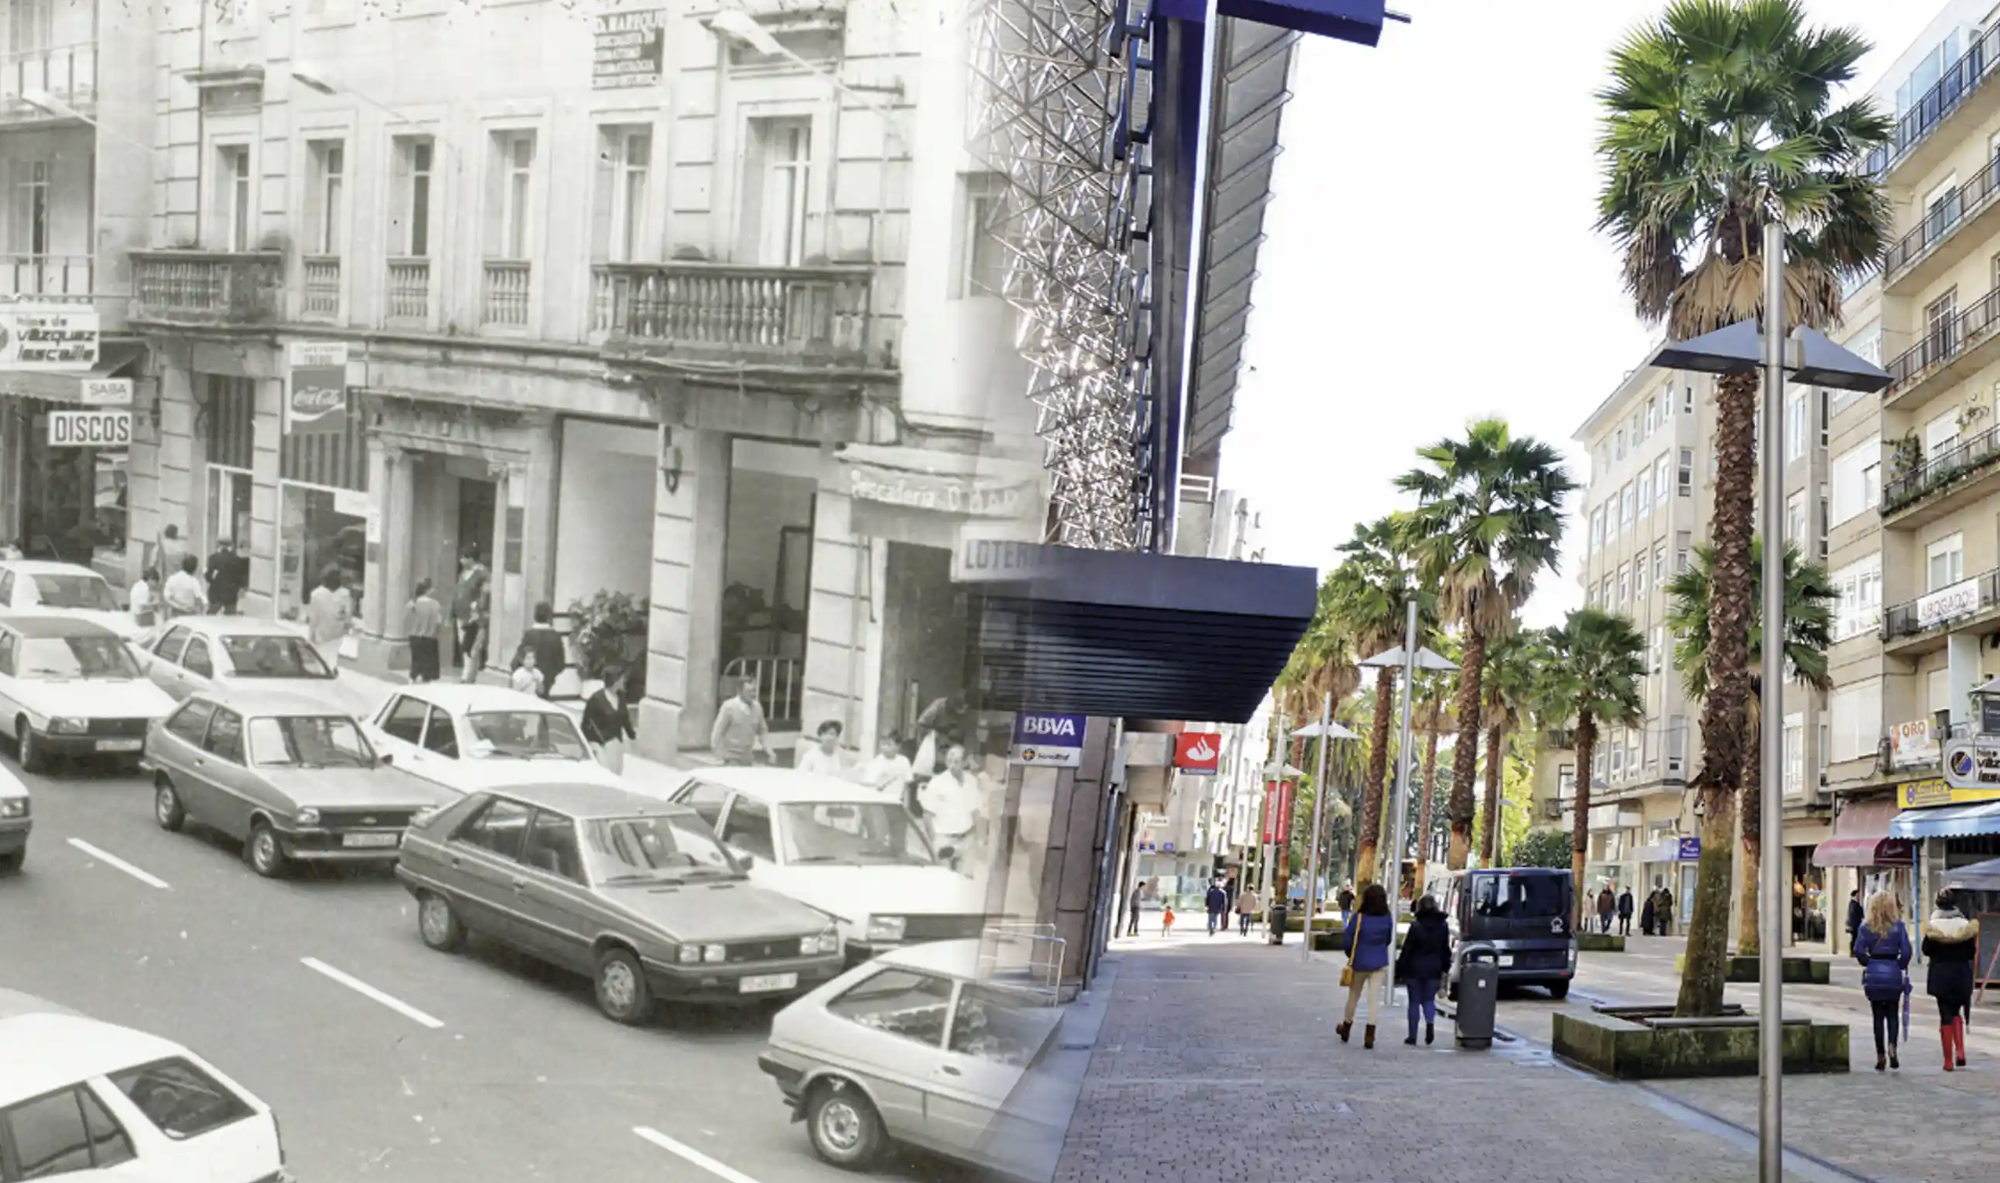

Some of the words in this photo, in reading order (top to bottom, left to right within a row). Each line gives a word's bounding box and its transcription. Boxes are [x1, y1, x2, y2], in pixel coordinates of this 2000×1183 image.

[89, 382, 127, 399] SABA
[55, 416, 129, 442] DISCOS
[1023, 716, 1075, 736] BBVA
[1902, 721, 1926, 738] ORO
